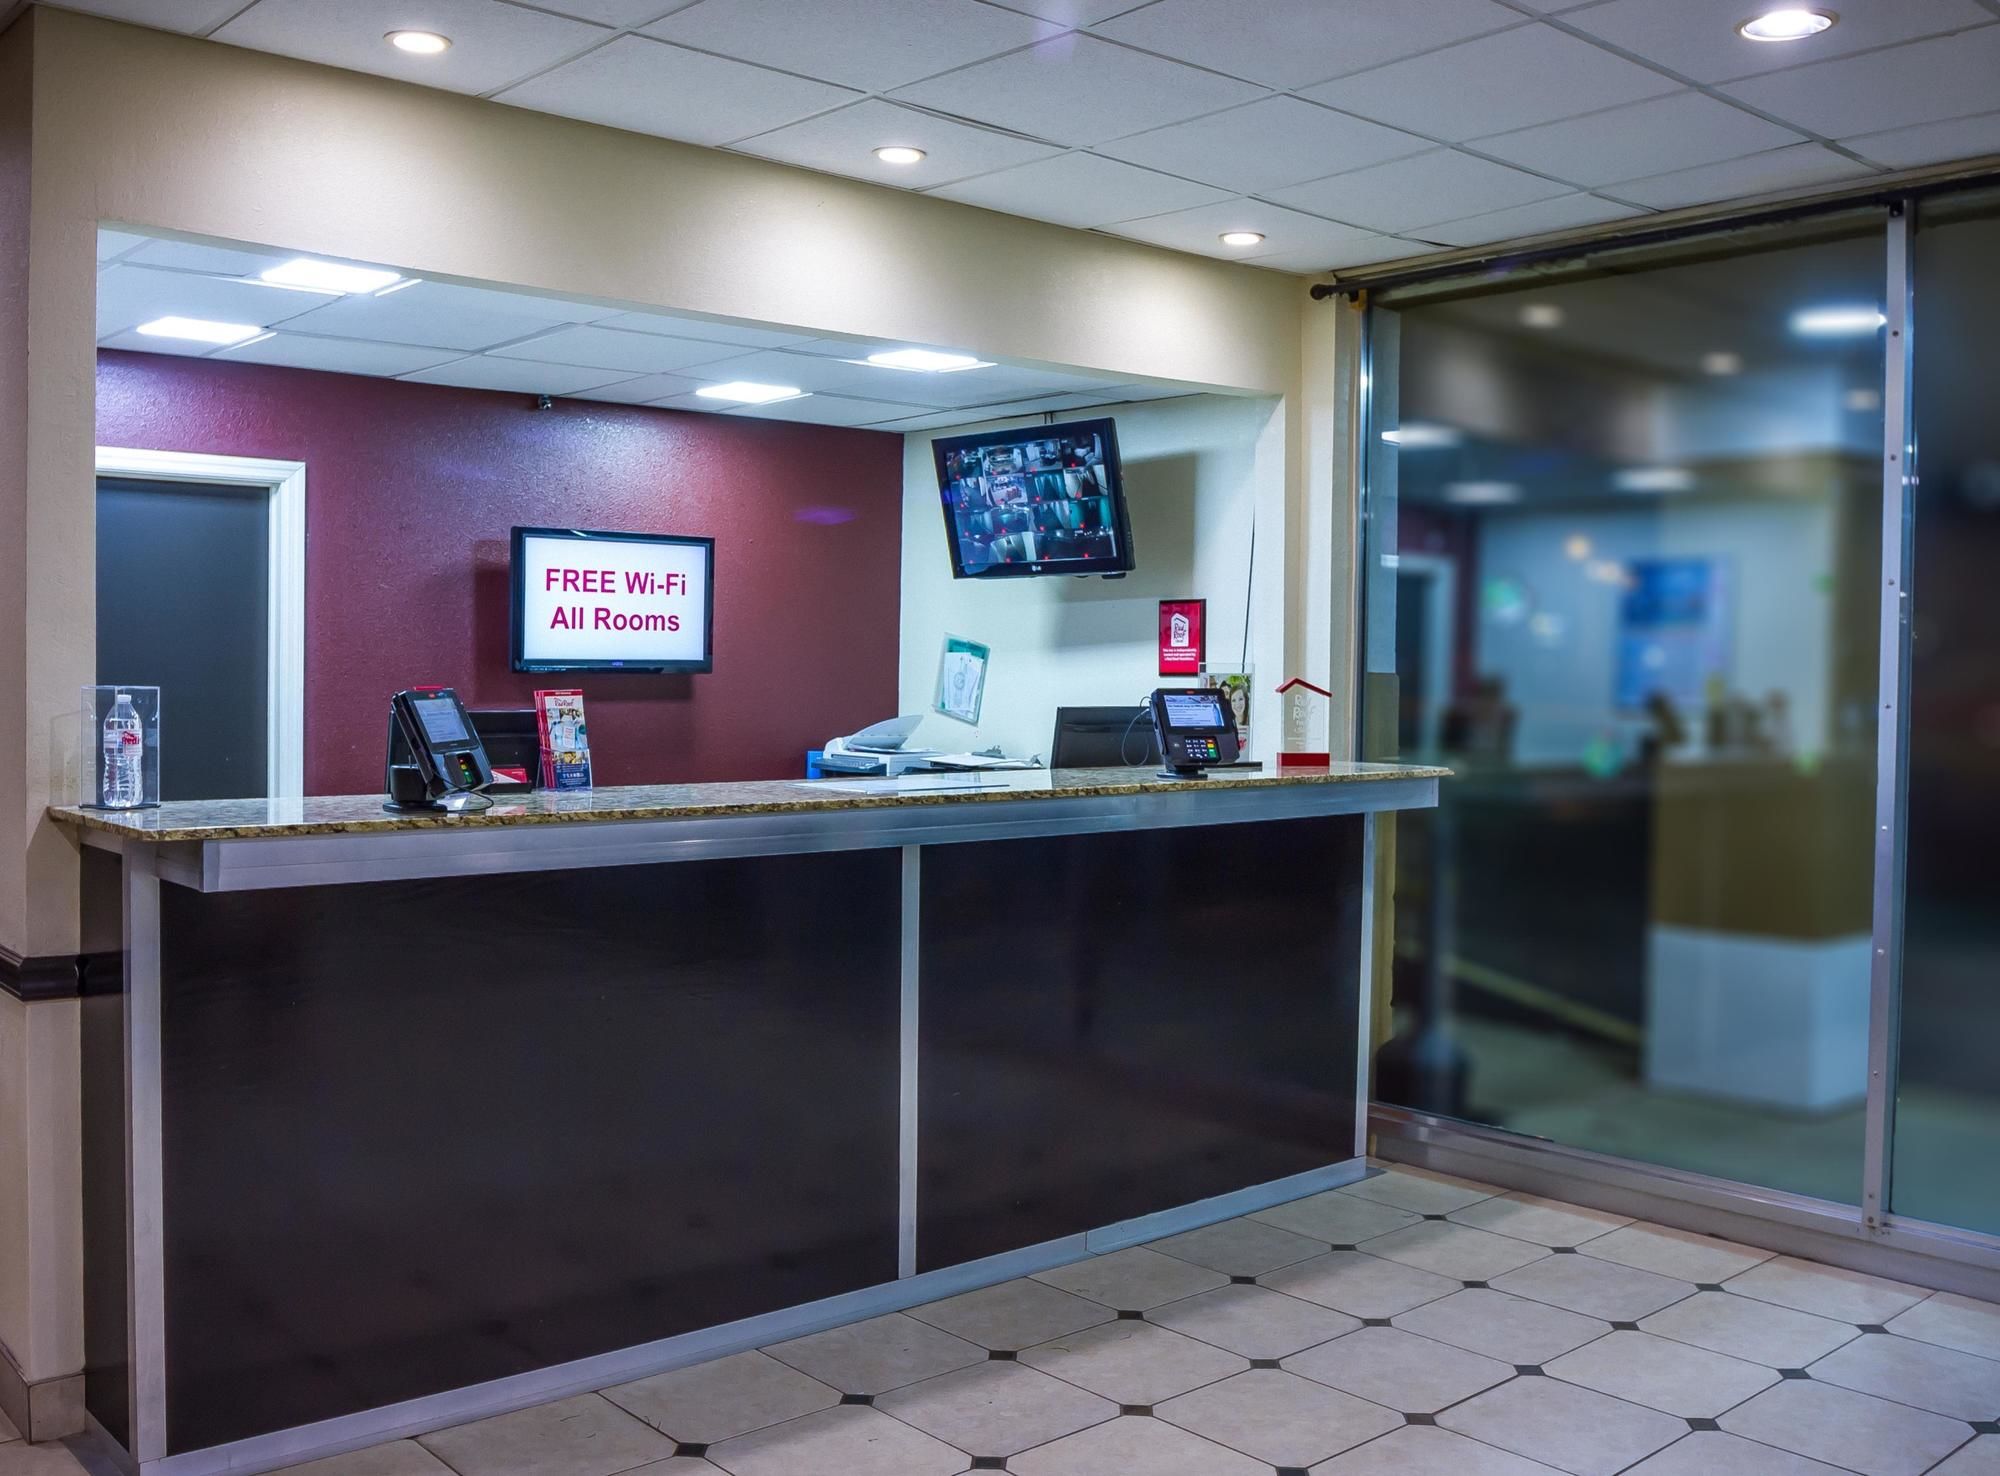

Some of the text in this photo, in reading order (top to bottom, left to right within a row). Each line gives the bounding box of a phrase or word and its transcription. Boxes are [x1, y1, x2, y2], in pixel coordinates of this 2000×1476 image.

[545, 568, 686, 596] FREE Wi-Fi
[550, 606, 680, 632] All Rooms
